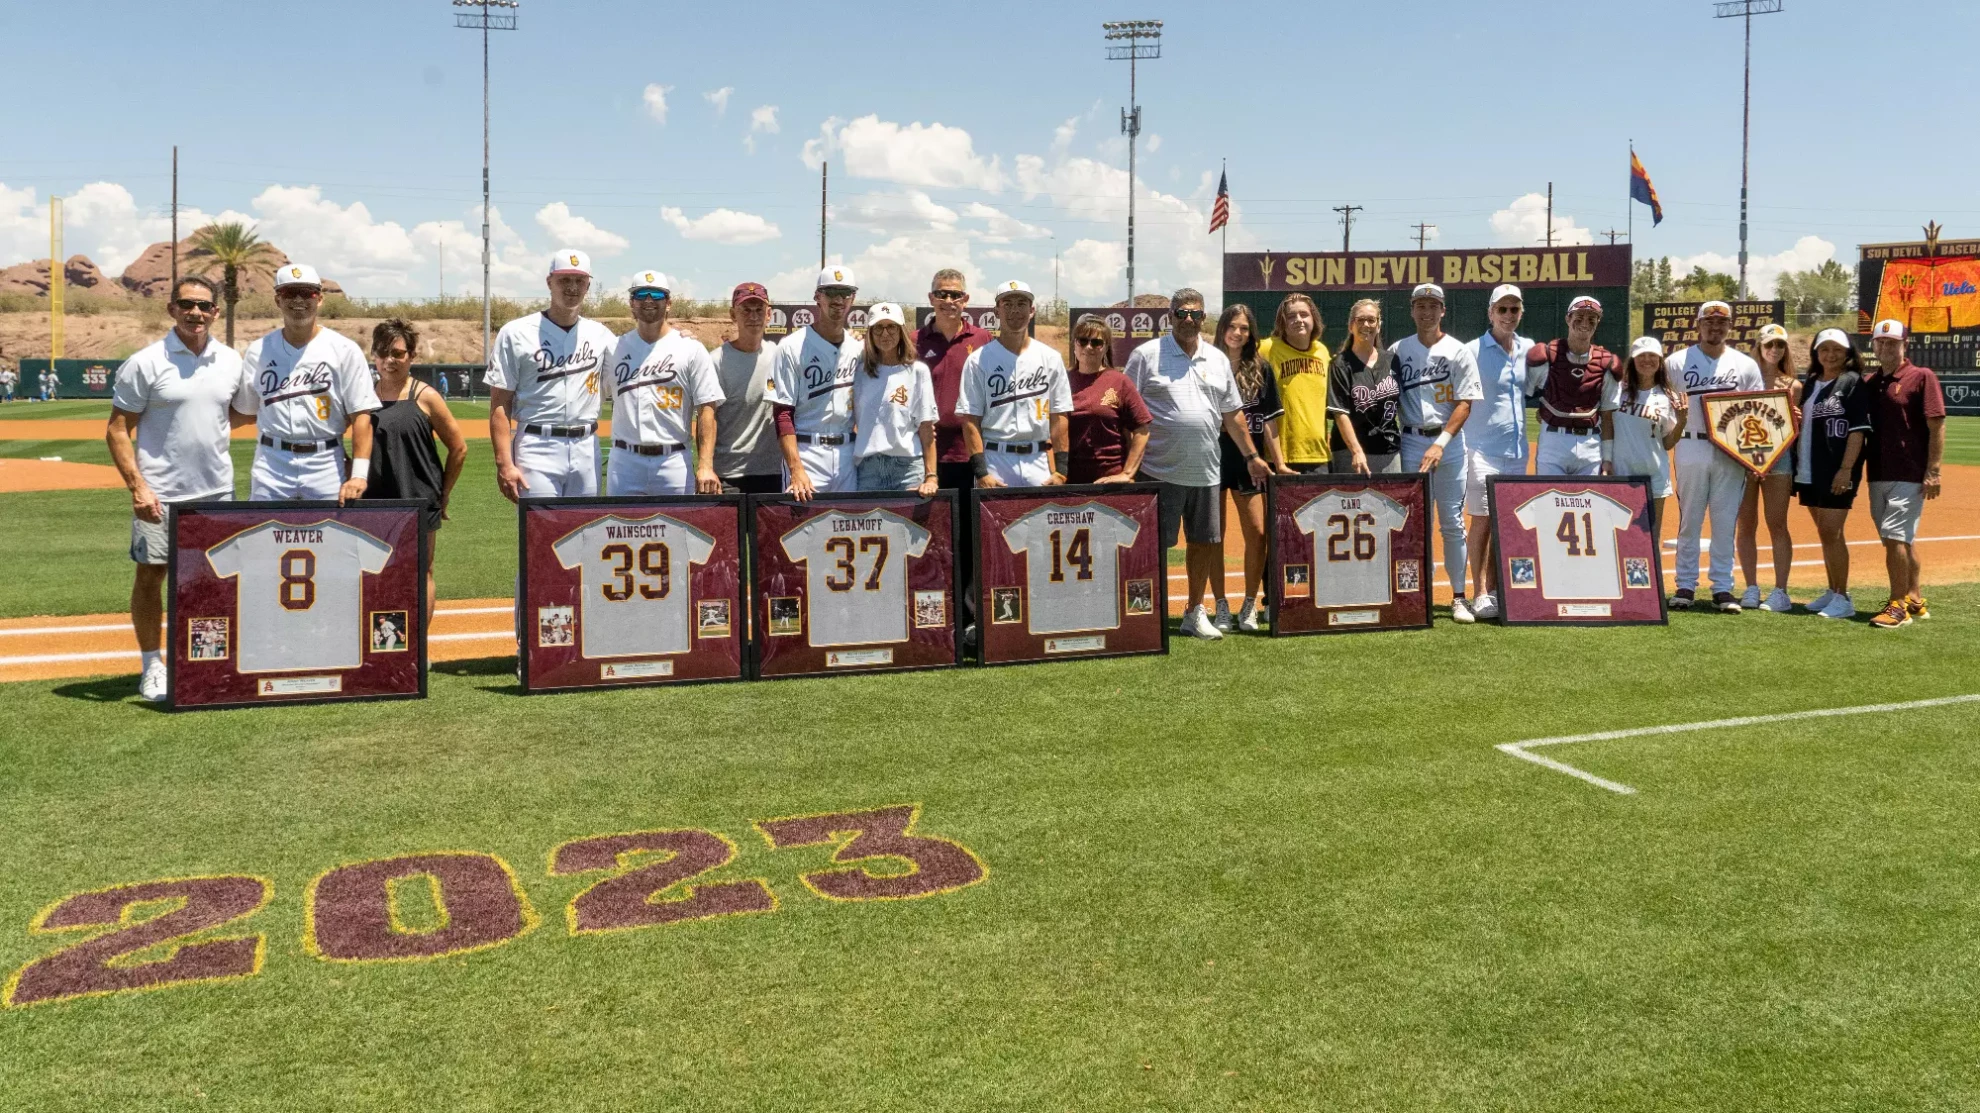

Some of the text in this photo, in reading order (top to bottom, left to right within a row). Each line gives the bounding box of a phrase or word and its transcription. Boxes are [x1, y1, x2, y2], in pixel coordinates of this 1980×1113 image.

[1867, 249, 1890, 259] SUN
[1893, 246, 1923, 257] DEVIL
[1285, 252, 1594, 286] SUN DEVIL BASEBALL
[795, 312, 811, 325] 33
[849, 313, 865, 325] 44
[1654, 306, 1696, 317] COLLEGE
[1735, 304, 1774, 315] SERIES
[983, 315, 996, 327] 14
[1109, 316, 1121, 328] 12
[1134, 316, 1150, 329] 24
[1924, 334, 1931, 344] 0
[1953, 334, 1960, 344] 0
[534, 341, 598, 377] Devils
[82, 373, 107, 385] 333
[259, 362, 332, 401] Devils
[615, 354, 677, 391] Devils
[804, 357, 857, 393] Devil
[1400, 357, 1451, 388] Devils
[1684, 368, 1739, 393] Devils
[987, 366, 1049, 402] Devils
[315, 395, 332, 421] 8
[656, 385, 684, 410] 39
[1383, 400, 1397, 420] 2
[1618, 400, 1662, 422] EVILS
[1826, 418, 1849, 438] 10
[1341, 498, 1361, 510] CANO
[1554, 497, 1592, 509] BALHOLM
[832, 518, 883, 533] LEBAMOFF
[1047, 511, 1095, 526] CRENSHAW
[273, 529, 324, 544] WEAVER
[606, 524, 667, 540] WAINSCOTT
[1327, 513, 1376, 562] 26
[1556, 511, 1597, 557] 41
[825, 535, 890, 593] 37
[1049, 528, 1094, 583] 14
[278, 548, 317, 612] 8
[601, 542, 671, 603] 39
[3, 802, 989, 1009] 2023
